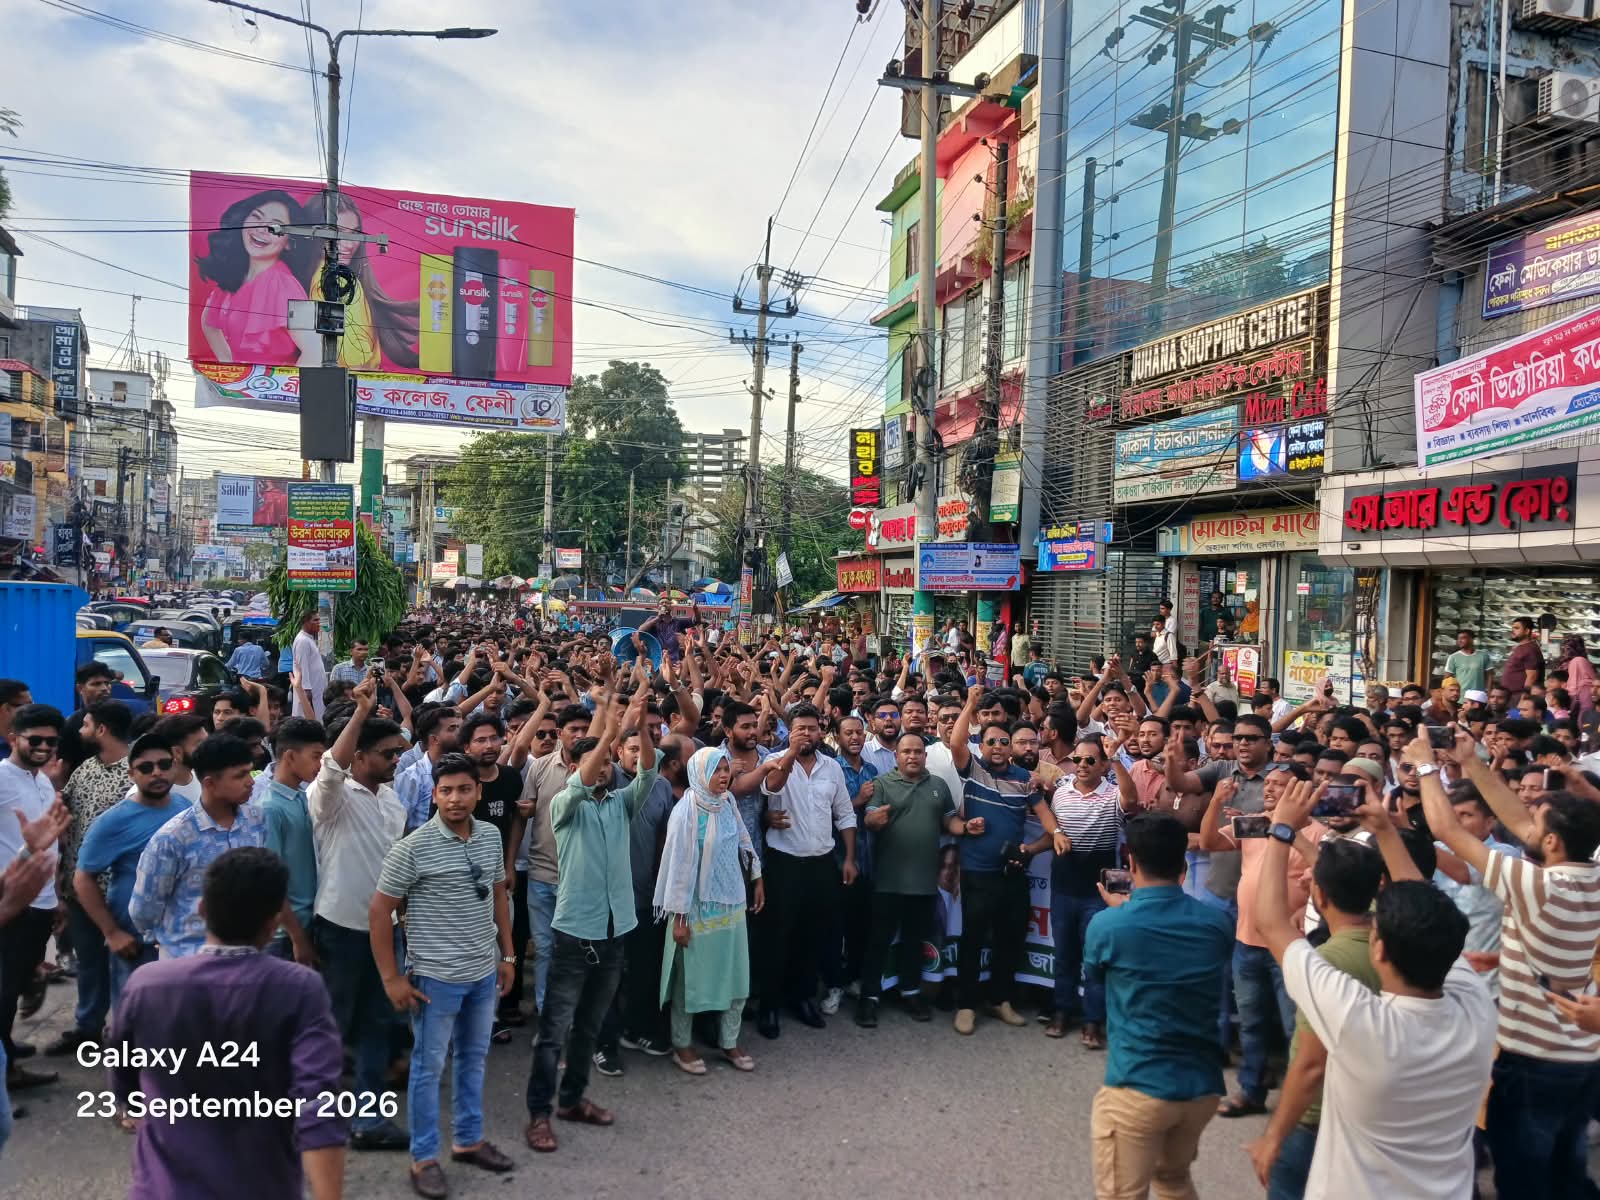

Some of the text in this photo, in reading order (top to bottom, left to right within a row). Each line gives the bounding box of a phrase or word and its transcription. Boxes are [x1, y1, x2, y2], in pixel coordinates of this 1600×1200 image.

[398, 199, 491, 219] বেছে নাও তোমার
[424, 215, 520, 242] sunsilk
[1489, 262, 1517, 293] ফেনী
[459, 287, 491, 298] sunsilk
[1130, 295, 1310, 382] JUHANA SHOPPING CENTRE
[1250, 349, 1305, 386] সেন্টার
[383, 387, 455, 410] কলেজ,
[466, 389, 517, 416] ফেনী
[1451, 372, 1485, 416] ফেনী
[1521, 404, 1557, 426] মানবিক
[221, 482, 251, 497] sailor
[1442, 483, 1494, 526] এন্ড
[1498, 475, 1570, 528] কোং
[313, 527, 351, 540] মোবারক
[1191, 513, 1265, 544] মোবাইল
